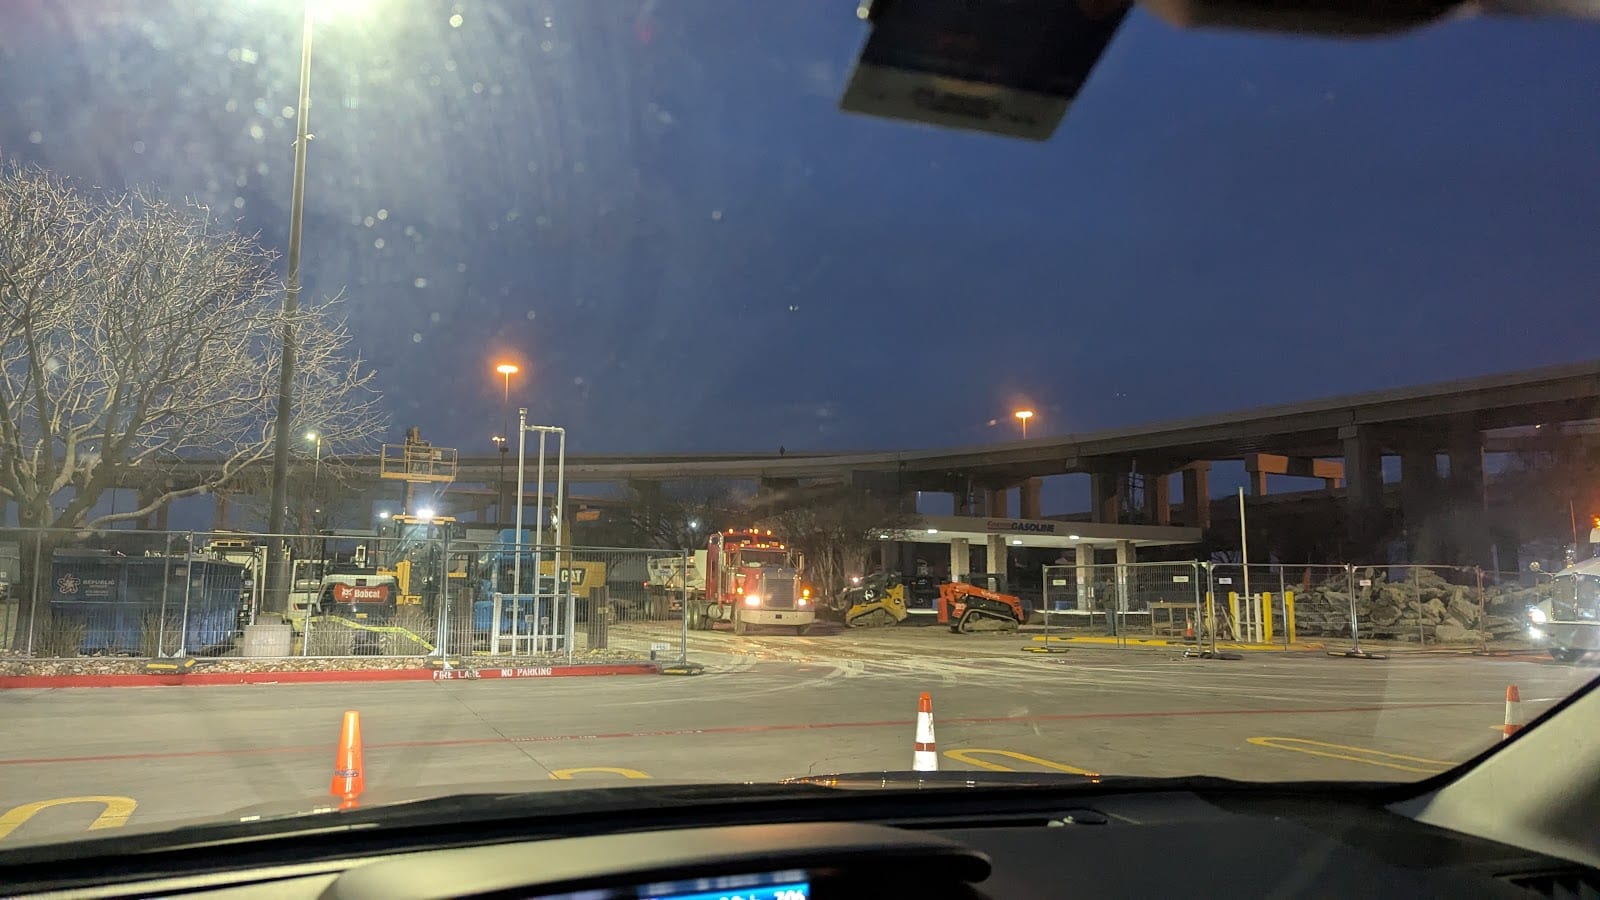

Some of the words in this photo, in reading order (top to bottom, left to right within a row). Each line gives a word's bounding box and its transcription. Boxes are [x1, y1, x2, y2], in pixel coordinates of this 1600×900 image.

[1011, 522, 1055, 532] GASOLINE
[561, 569, 582, 583] CAT
[354, 589, 380, 599] Bobcat
[433, 670, 454, 680] FIRE
[501, 668, 513, 678] NO
[516, 667, 552, 677] PARKING
